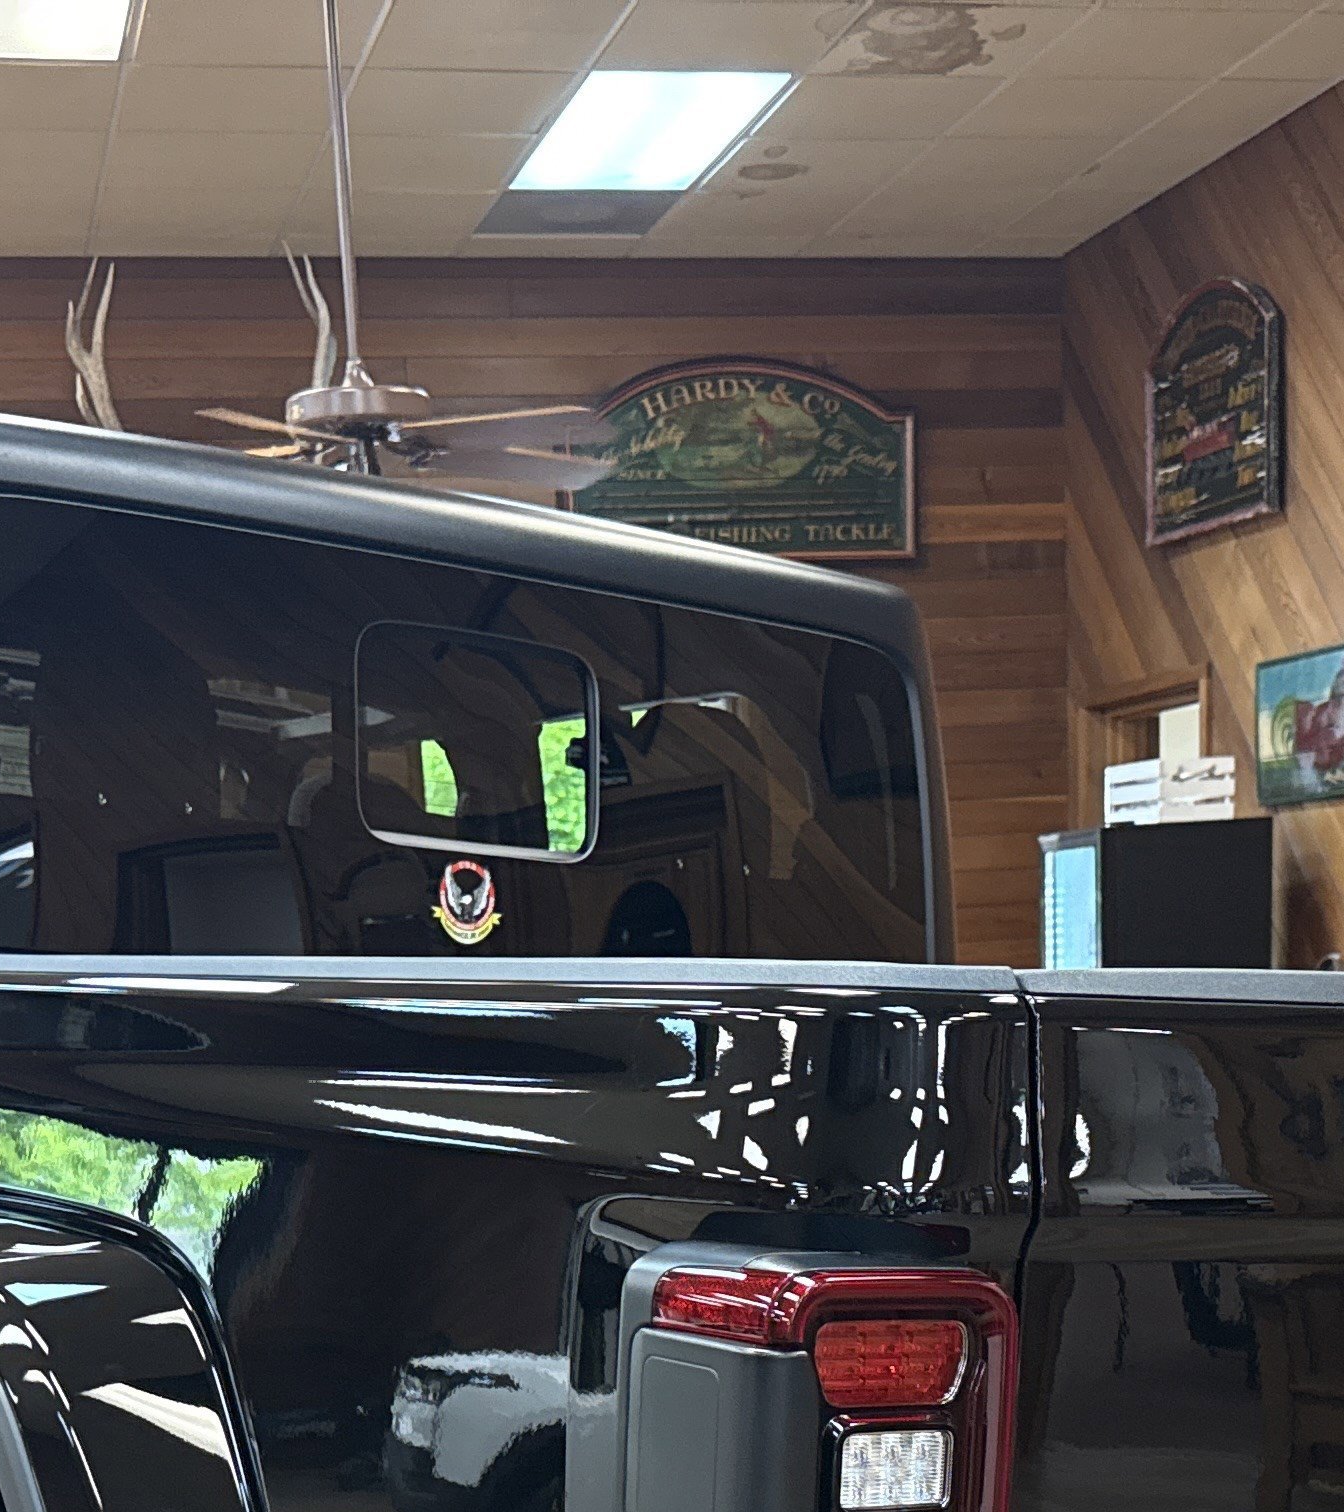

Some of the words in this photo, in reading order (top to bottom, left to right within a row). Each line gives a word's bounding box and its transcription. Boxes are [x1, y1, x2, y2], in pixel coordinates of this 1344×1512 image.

[641, 378, 764, 420] HARDY
[770, 382, 795, 408] &
[805, 523, 895, 542] TACKLE
